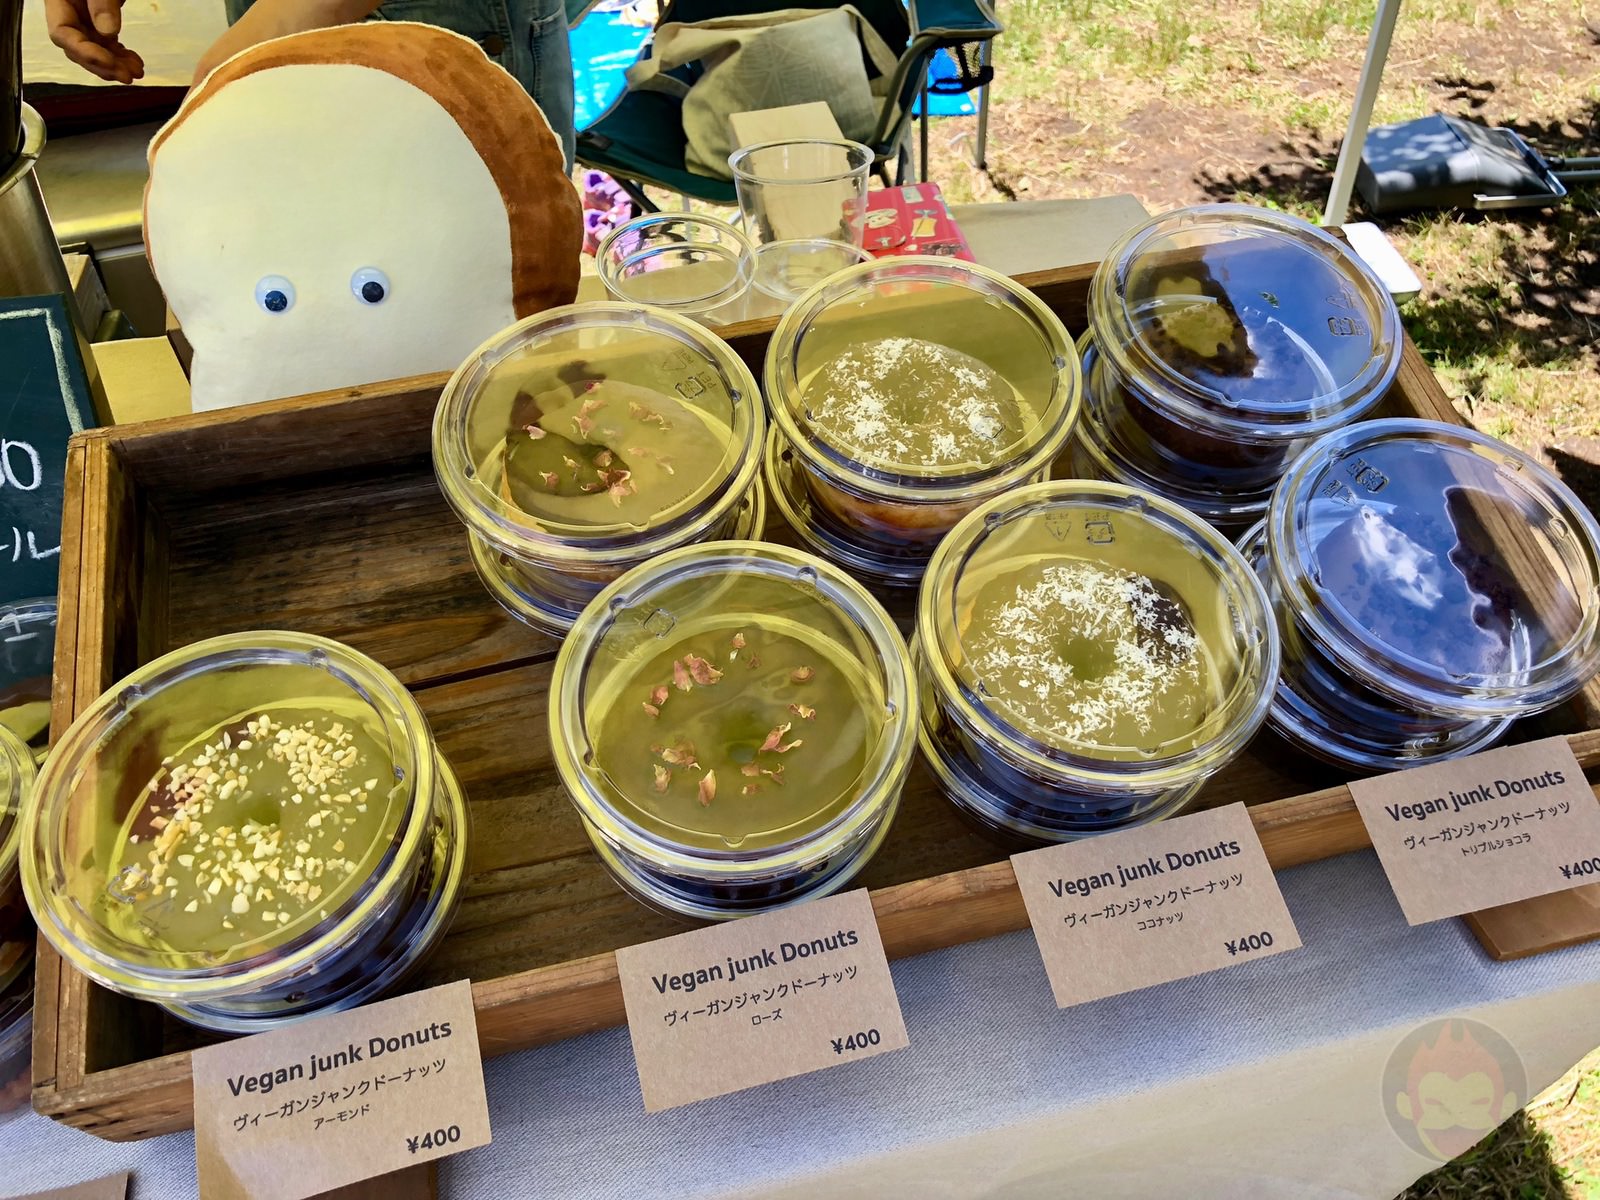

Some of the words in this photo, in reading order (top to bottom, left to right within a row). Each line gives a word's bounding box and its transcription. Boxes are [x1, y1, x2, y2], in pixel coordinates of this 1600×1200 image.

[1385, 796, 1448, 821] Vegan
[1449, 784, 1495, 812] junk
[1495, 770, 1565, 798] Donuts
[1404, 801, 1570, 850] ヴィーガンジャンクドーナッツ
[1461, 832, 1532, 856] トリプルショコラ
[1048, 870, 1115, 898] Vegan
[1117, 857, 1164, 887] junk
[1166, 840, 1241, 871] Donuts
[1064, 873, 1243, 928] ヴィーガンジャンクドーナッツ
[1137, 911, 1184, 931] ココナッツ
[651, 964, 723, 994] Vegan
[727, 949, 777, 981] junk
[780, 929, 859, 962] Donuts
[1224, 931, 1273, 956] ¥400
[664, 965, 857, 1026] ヴィーガンジャンクドーナッツ
[752, 1008, 783, 1026] ローズ
[227, 1063, 303, 1097] Vegan
[309, 1044, 363, 1080] junk
[369, 1021, 452, 1057] Donuts
[831, 1028, 881, 1054] ¥400
[234, 1058, 446, 1131] ヴィーガンジャンクドーナッツ
[314, 1104, 370, 1130] アーモンド
[406, 1124, 461, 1154] ¥400
